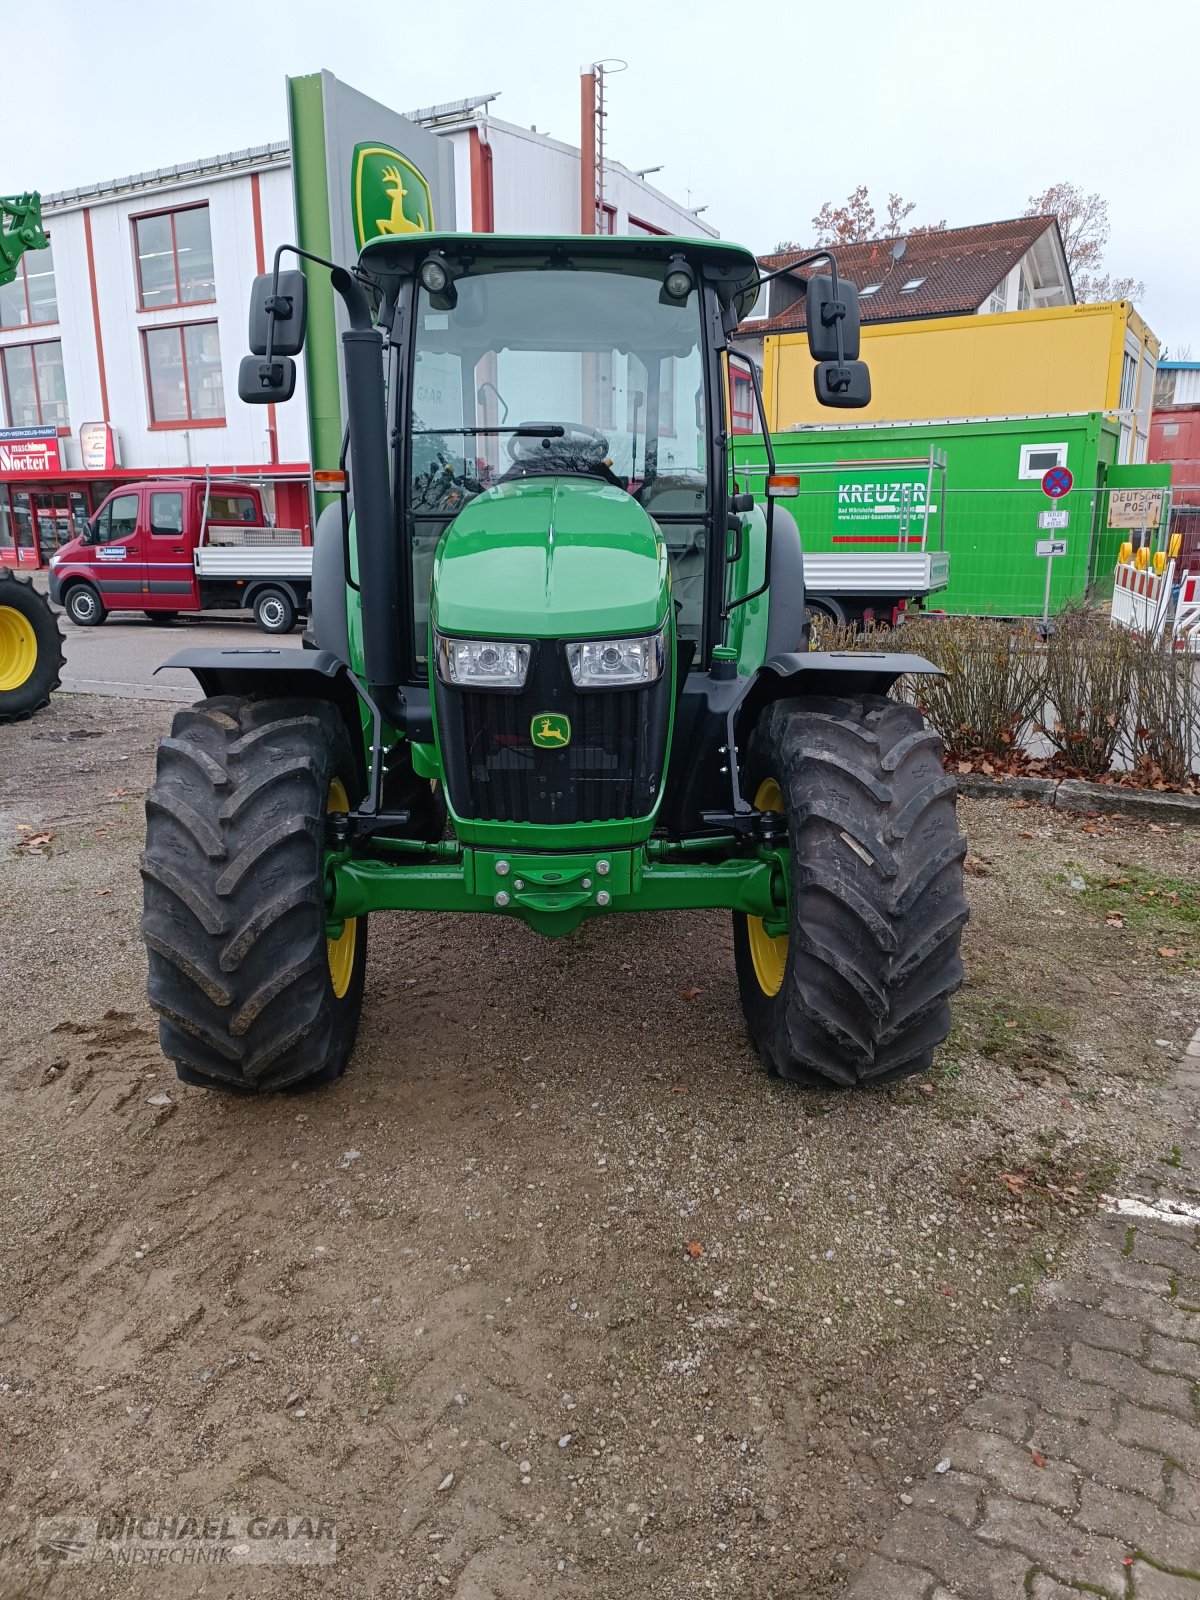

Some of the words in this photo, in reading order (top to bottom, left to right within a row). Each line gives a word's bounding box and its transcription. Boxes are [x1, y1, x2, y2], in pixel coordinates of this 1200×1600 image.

[838, 483, 926, 503] KREUZER
[1112, 491, 1162, 503] DEUTSCHE
[1124, 502, 1153, 512] POST
